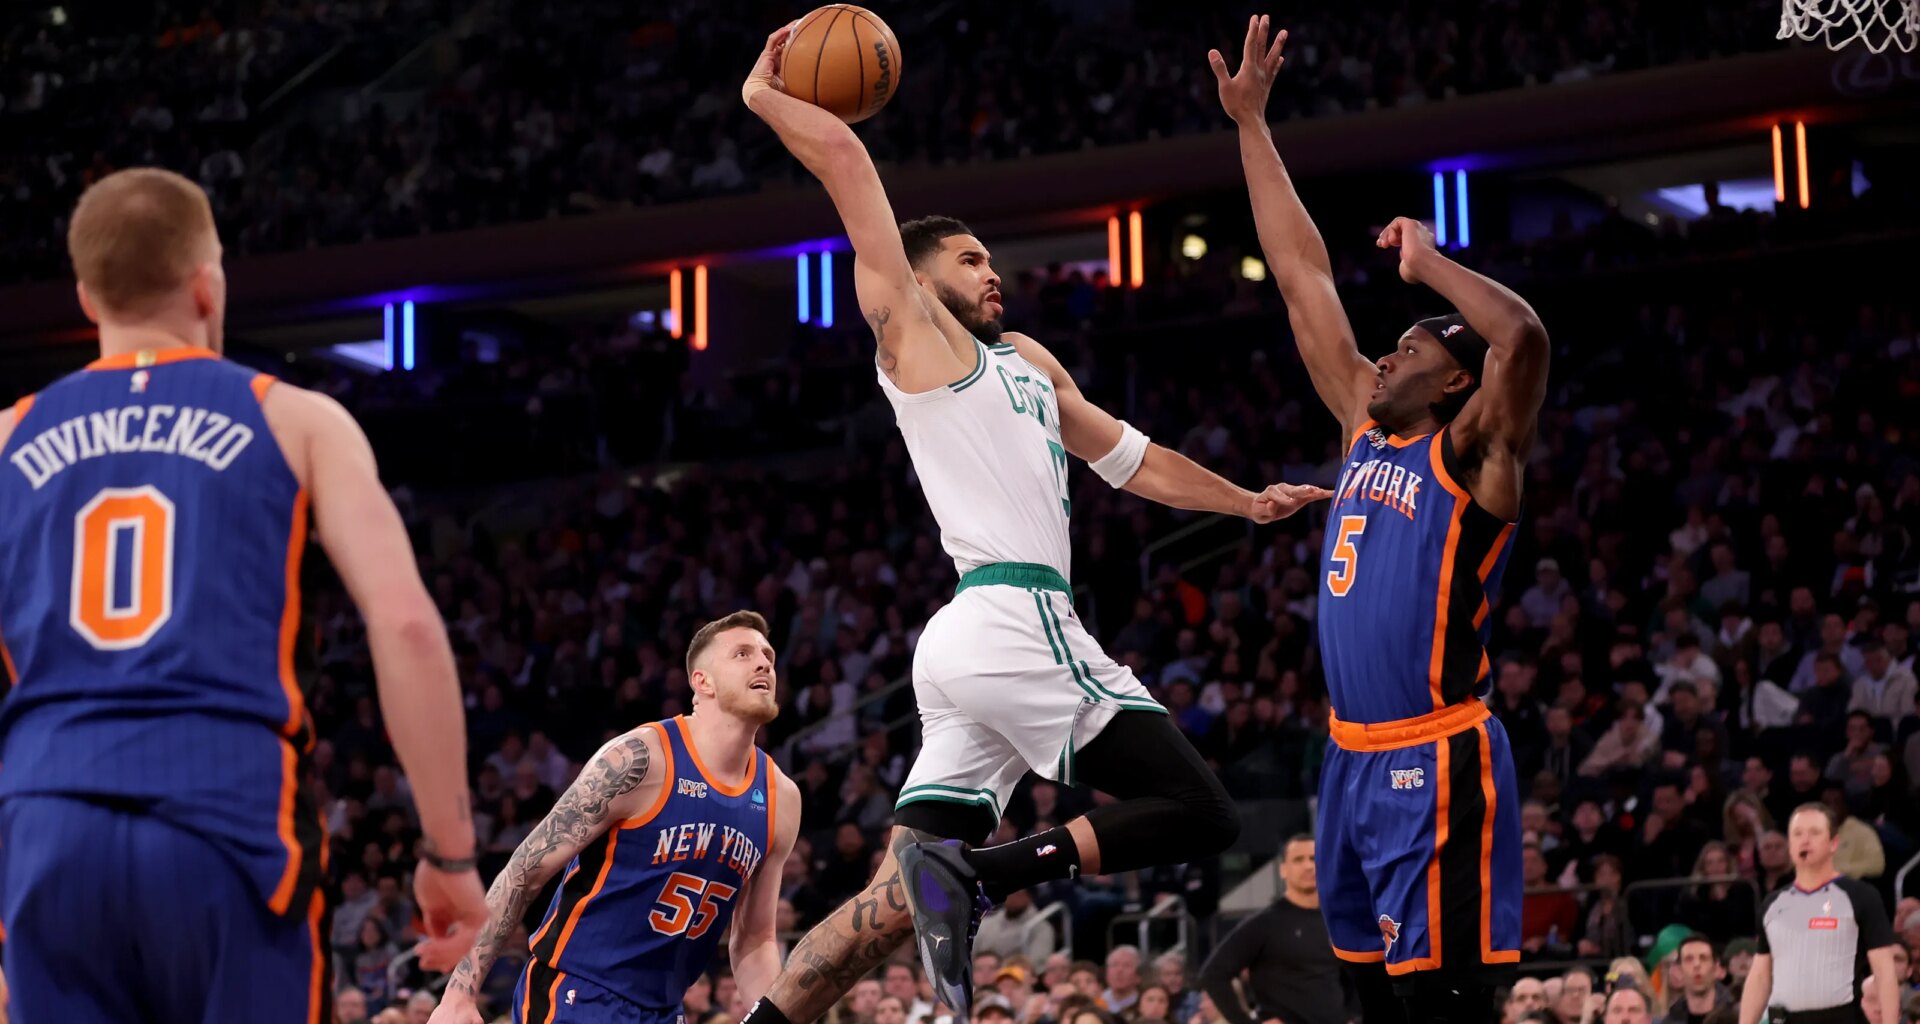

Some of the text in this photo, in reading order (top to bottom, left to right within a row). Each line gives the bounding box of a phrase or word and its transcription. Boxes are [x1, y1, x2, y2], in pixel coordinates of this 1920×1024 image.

[10, 404, 254, 490] DIVINCENZO
[69, 484, 176, 651] 0
[1327, 515, 1367, 597] 5
[677, 777, 708, 799] NYC
[1390, 767, 1424, 790] NYC
[652, 822, 762, 881] NEW YORK
[647, 871, 738, 940] 55
